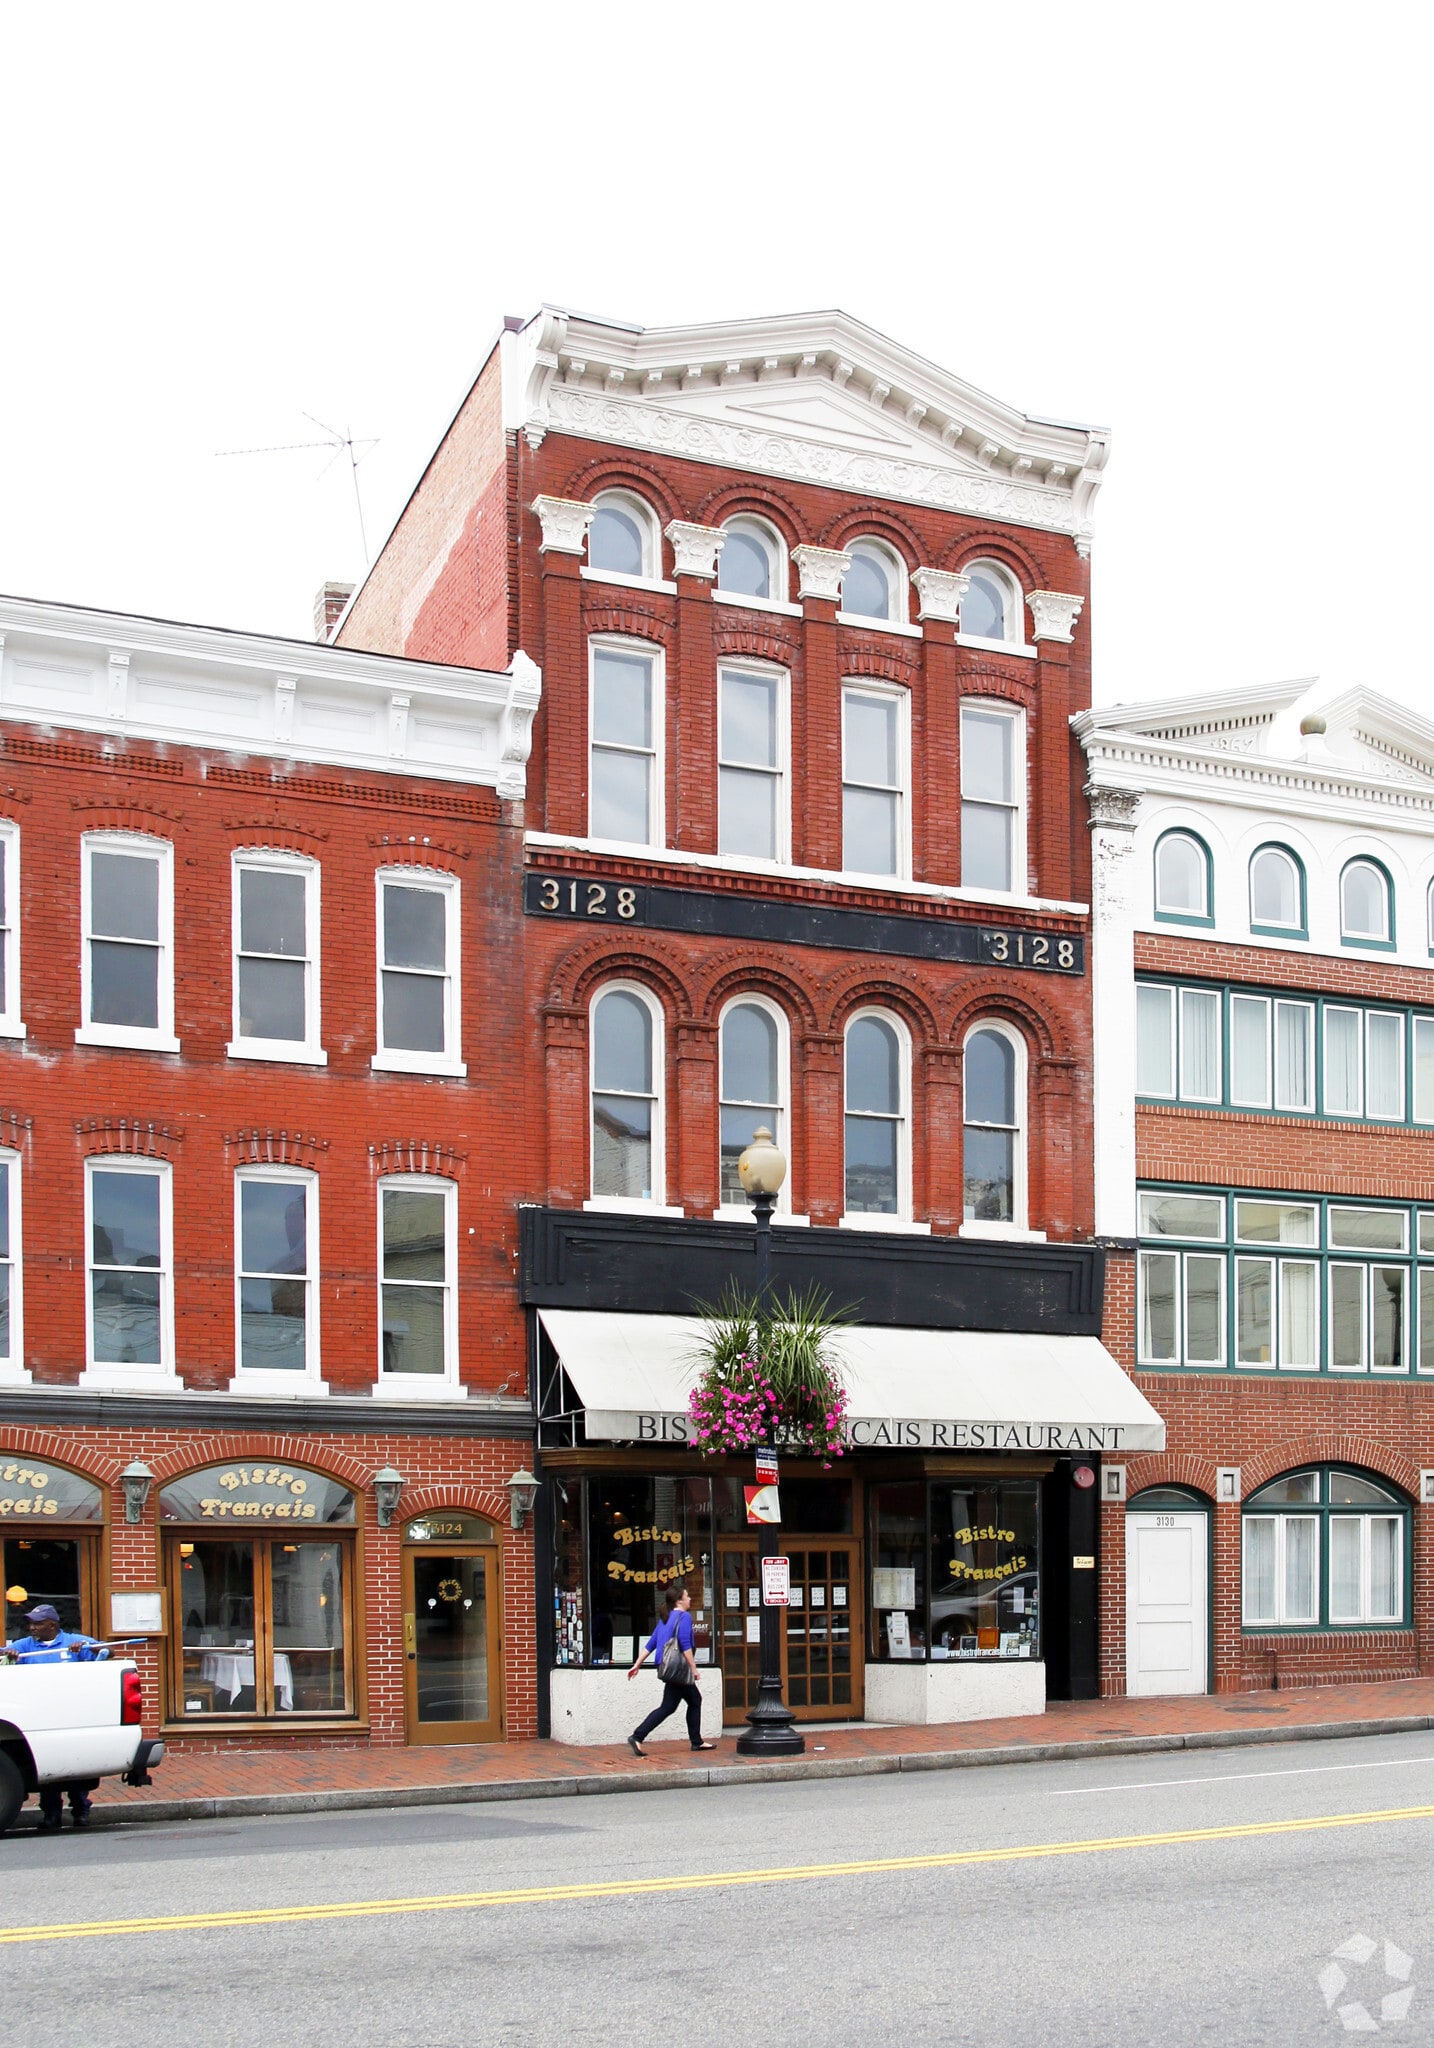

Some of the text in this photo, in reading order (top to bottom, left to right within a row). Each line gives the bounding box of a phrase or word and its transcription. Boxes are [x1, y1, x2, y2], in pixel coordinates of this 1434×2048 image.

[539, 879, 636, 919] 3128
[991, 932, 1074, 969] 3128
[636, 1415, 688, 1441] BIS
[931, 1423, 1125, 1449] RESTAURANT
[0, 1464, 49, 1489] tro
[218, 1466, 307, 1495] Bistro
[200, 1498, 316, 1519] Français
[433, 1523, 463, 1534] 3124
[1156, 1516, 1175, 1527] 3130
[613, 1525, 682, 1546] Bistro
[954, 1525, 1016, 1545] Bistro
[607, 1557, 695, 1584] Français
[949, 1555, 1028, 1581] Français
